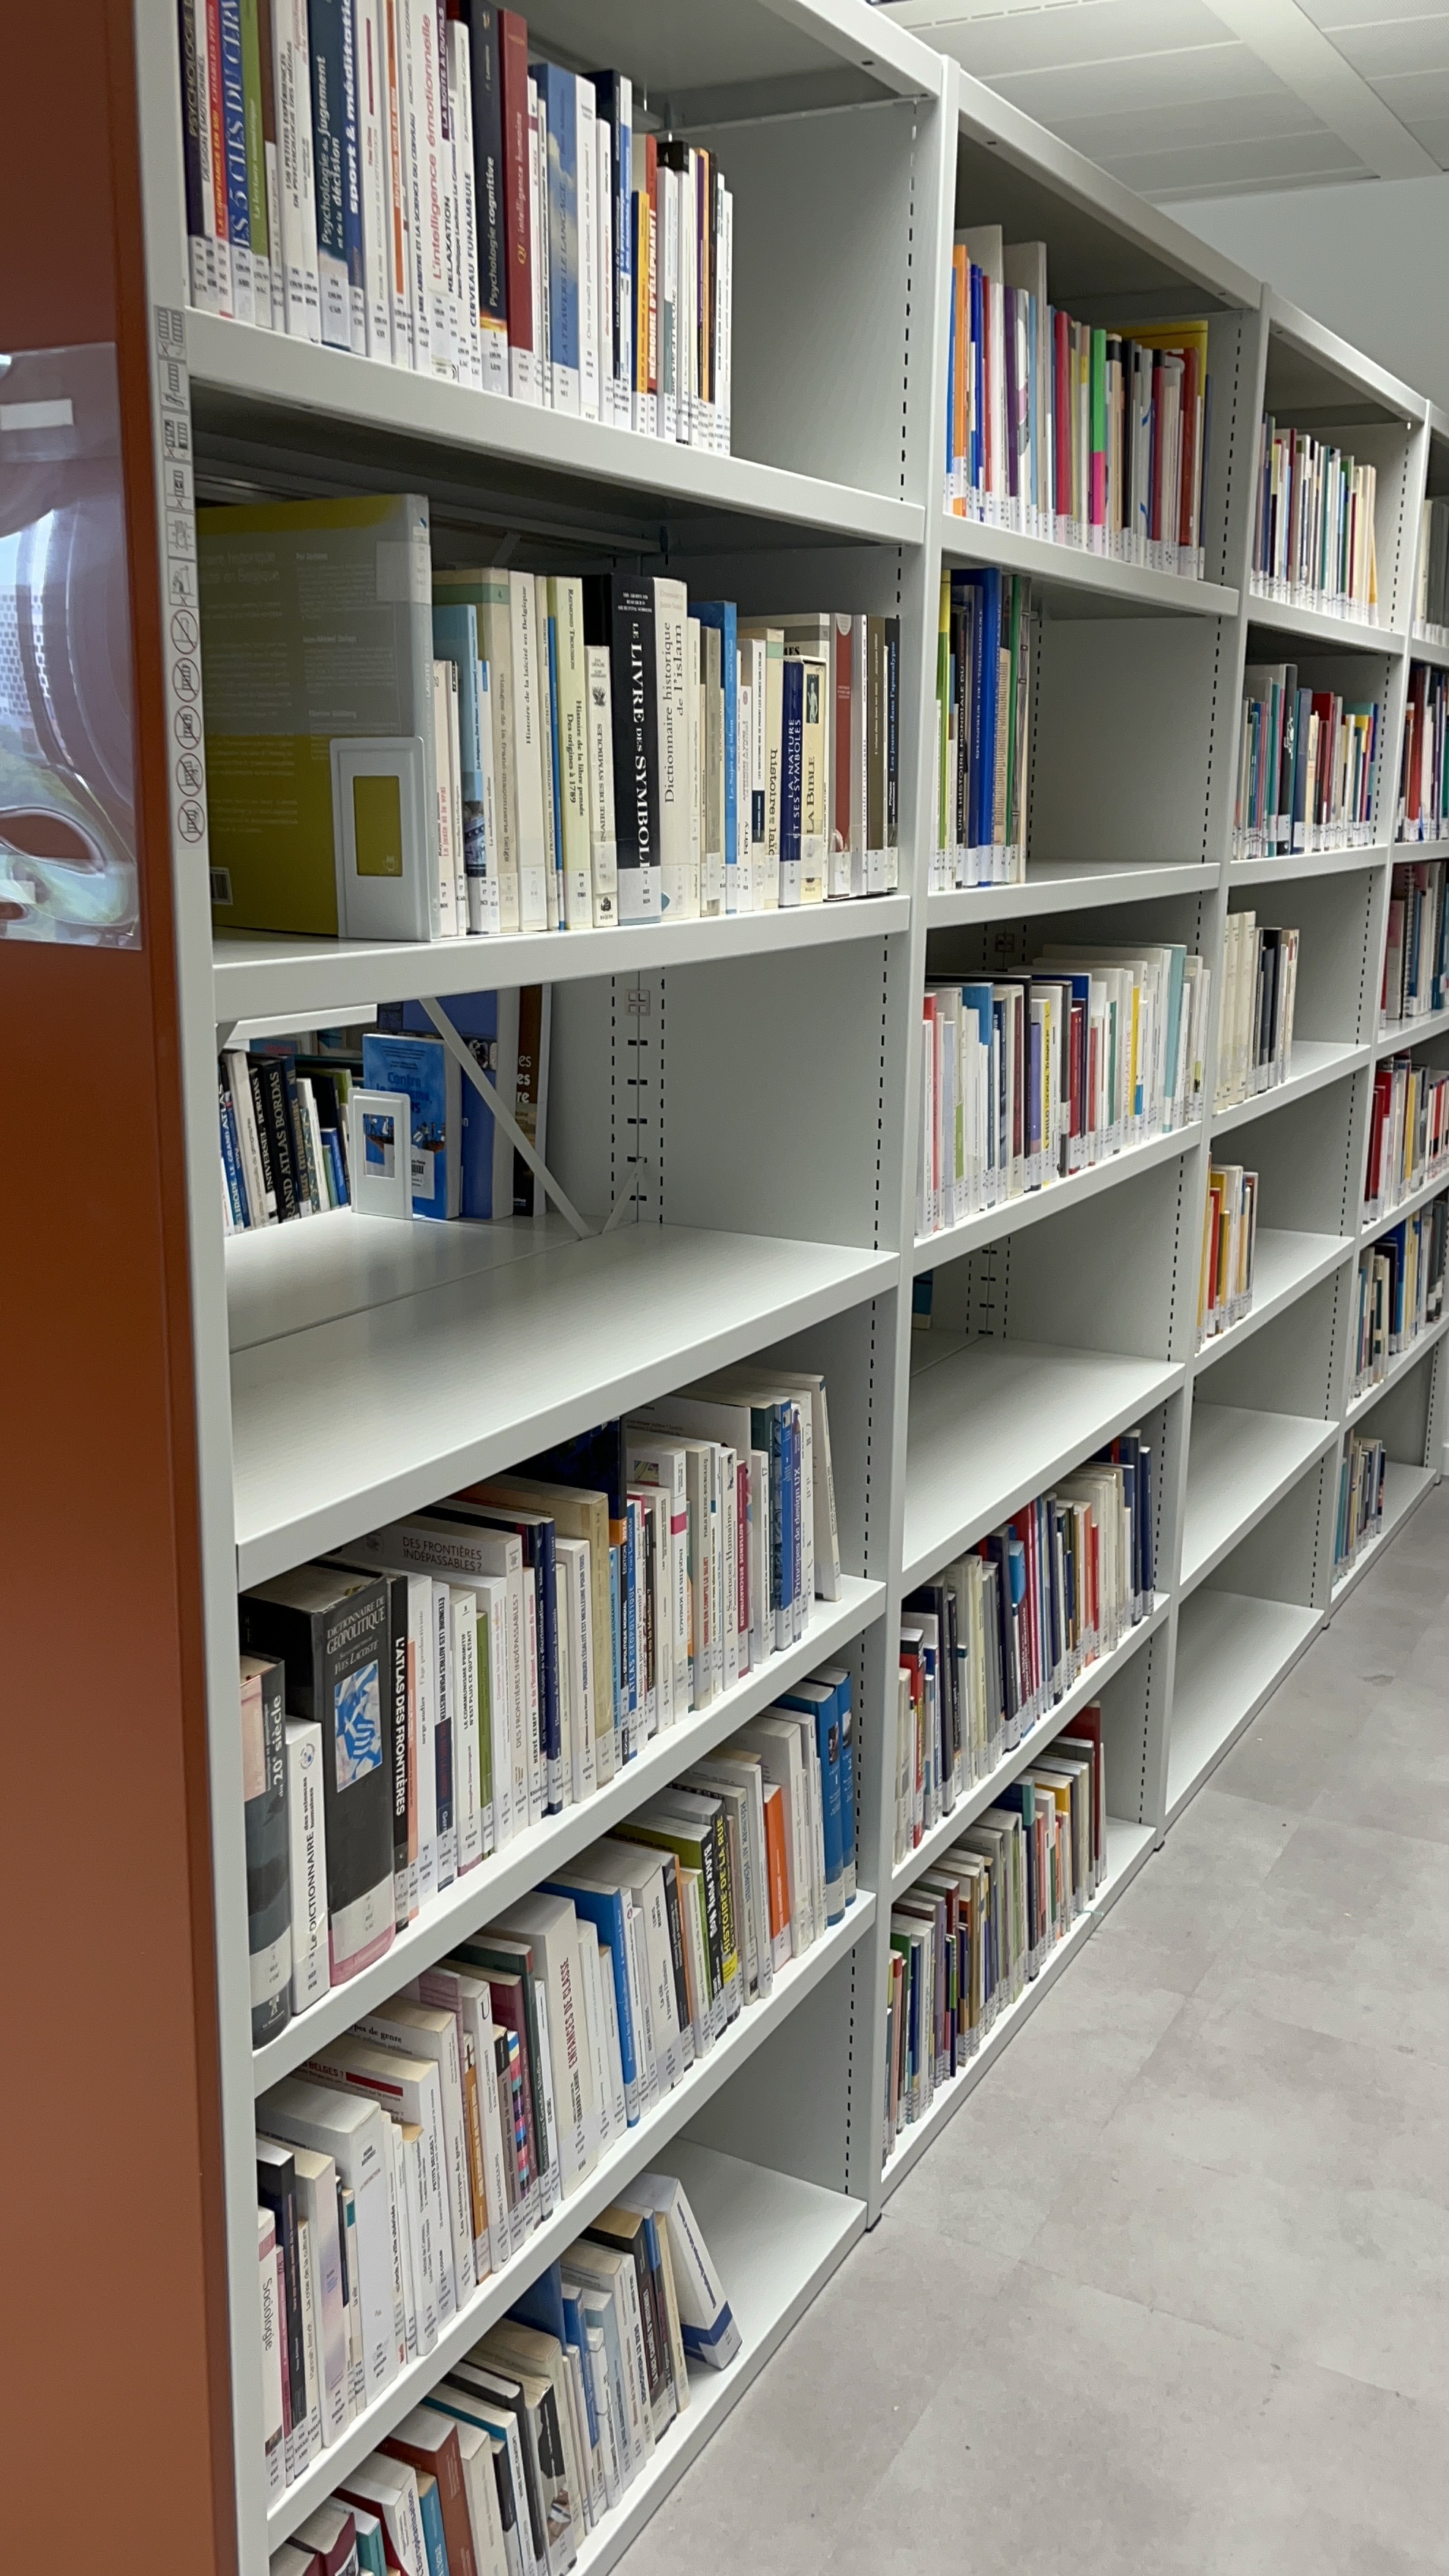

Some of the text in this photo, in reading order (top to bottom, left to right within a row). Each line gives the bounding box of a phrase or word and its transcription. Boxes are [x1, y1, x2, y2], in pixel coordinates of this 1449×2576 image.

[331, 136, 342, 206] décision
[422, 12, 442, 280] L'intelligence émotionnelle
[318, 152, 333, 244] Psychologie
[347, 143, 359, 214] sport
[515, 165, 527, 234] intelligence
[465, 171, 477, 326] CERVEAU FUNAMBULE
[486, 154, 500, 307] Psychologie cognitive
[556, 184, 565, 255] LANGAGE
[558, 257, 566, 274] LE
[558, 277, 568, 341] TRAVERS
[648, 312, 656, 379] MÉMOIRE
[520, 585, 528, 631] Belgique
[523, 679, 530, 689] la
[524, 691, 531, 703] de
[673, 624, 684, 716] de l'islam
[577, 739, 583, 750] de
[632, 622, 651, 866] LE LIVRE DES SYMBOL
[662, 621, 675, 804] Dictionnaire historique
[577, 752, 583, 761] la
[596, 724, 604, 782] SYMBOLES
[769, 748, 778, 815] histoire
[577, 785, 585, 816] pensée
[787, 781, 794, 798] LA
[806, 757, 815, 835] LA BIBLE
[252, 1077, 265, 1125] BORDAS
[269, 1070, 285, 1128] BORDAS
[277, 1129, 291, 1175] ATLAS
[403, 1537, 482, 1560] DES FRONTIÈRES
[403, 1548, 475, 1571] INDÉPASSABLES
[725, 1505, 733, 1561] Humaines
[793, 1467, 803, 1594] Principes de design UX
[725, 1564, 734, 1612] Sciences
[512, 1600, 520, 1671] INDÉPASSABLES
[514, 1672, 522, 1729] FRONTIÈRES
[628, 1658, 636, 1692] ATLAS
[271, 1695, 282, 1753] siècle
[395, 1636, 408, 1816] L'ATLAS DES FRONTIÈRES
[305, 1832, 317, 1933] DICTIONNAIRE
[716, 1816, 732, 1955] HISTOIRE DE LA RUE
[307, 1934, 318, 1951] Le
[381, 2032, 403, 2044] genre
[560, 1957, 578, 2070] ENFANCES DE CLASSE
[261, 2277, 274, 2353] Sociologie
